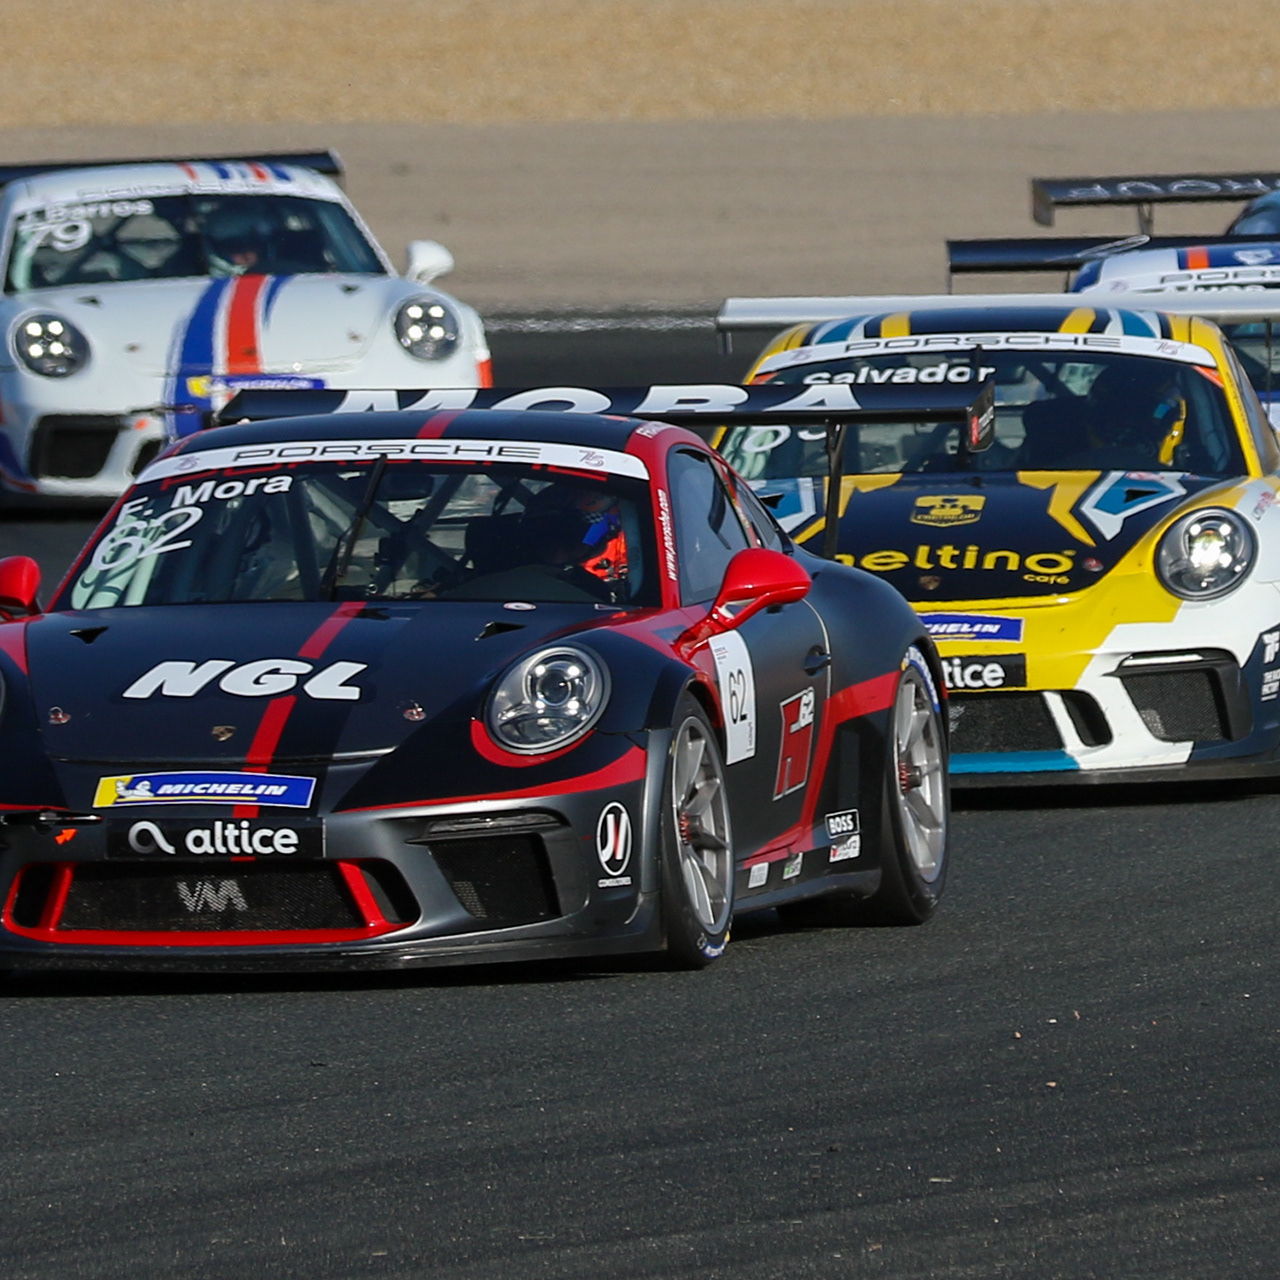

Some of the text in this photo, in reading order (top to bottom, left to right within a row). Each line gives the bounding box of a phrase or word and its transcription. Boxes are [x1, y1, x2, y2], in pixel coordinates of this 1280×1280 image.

[845, 334, 1122, 353] PORSCHE
[803, 362, 996, 385] Salvador
[233, 444, 542, 462] PORSCHE
[116, 474, 294, 526] F. Mora
[91, 505, 204, 571] 62
[1023, 573, 1070, 585] café
[924, 623, 1001, 634] HELIN
[122, 658, 368, 700] NGL
[941, 657, 1006, 689] tice
[729, 668, 748, 725] 62
[157, 784, 288, 796] MICHELIN
[828, 814, 855, 834] BOSS
[185, 820, 299, 854] altice
